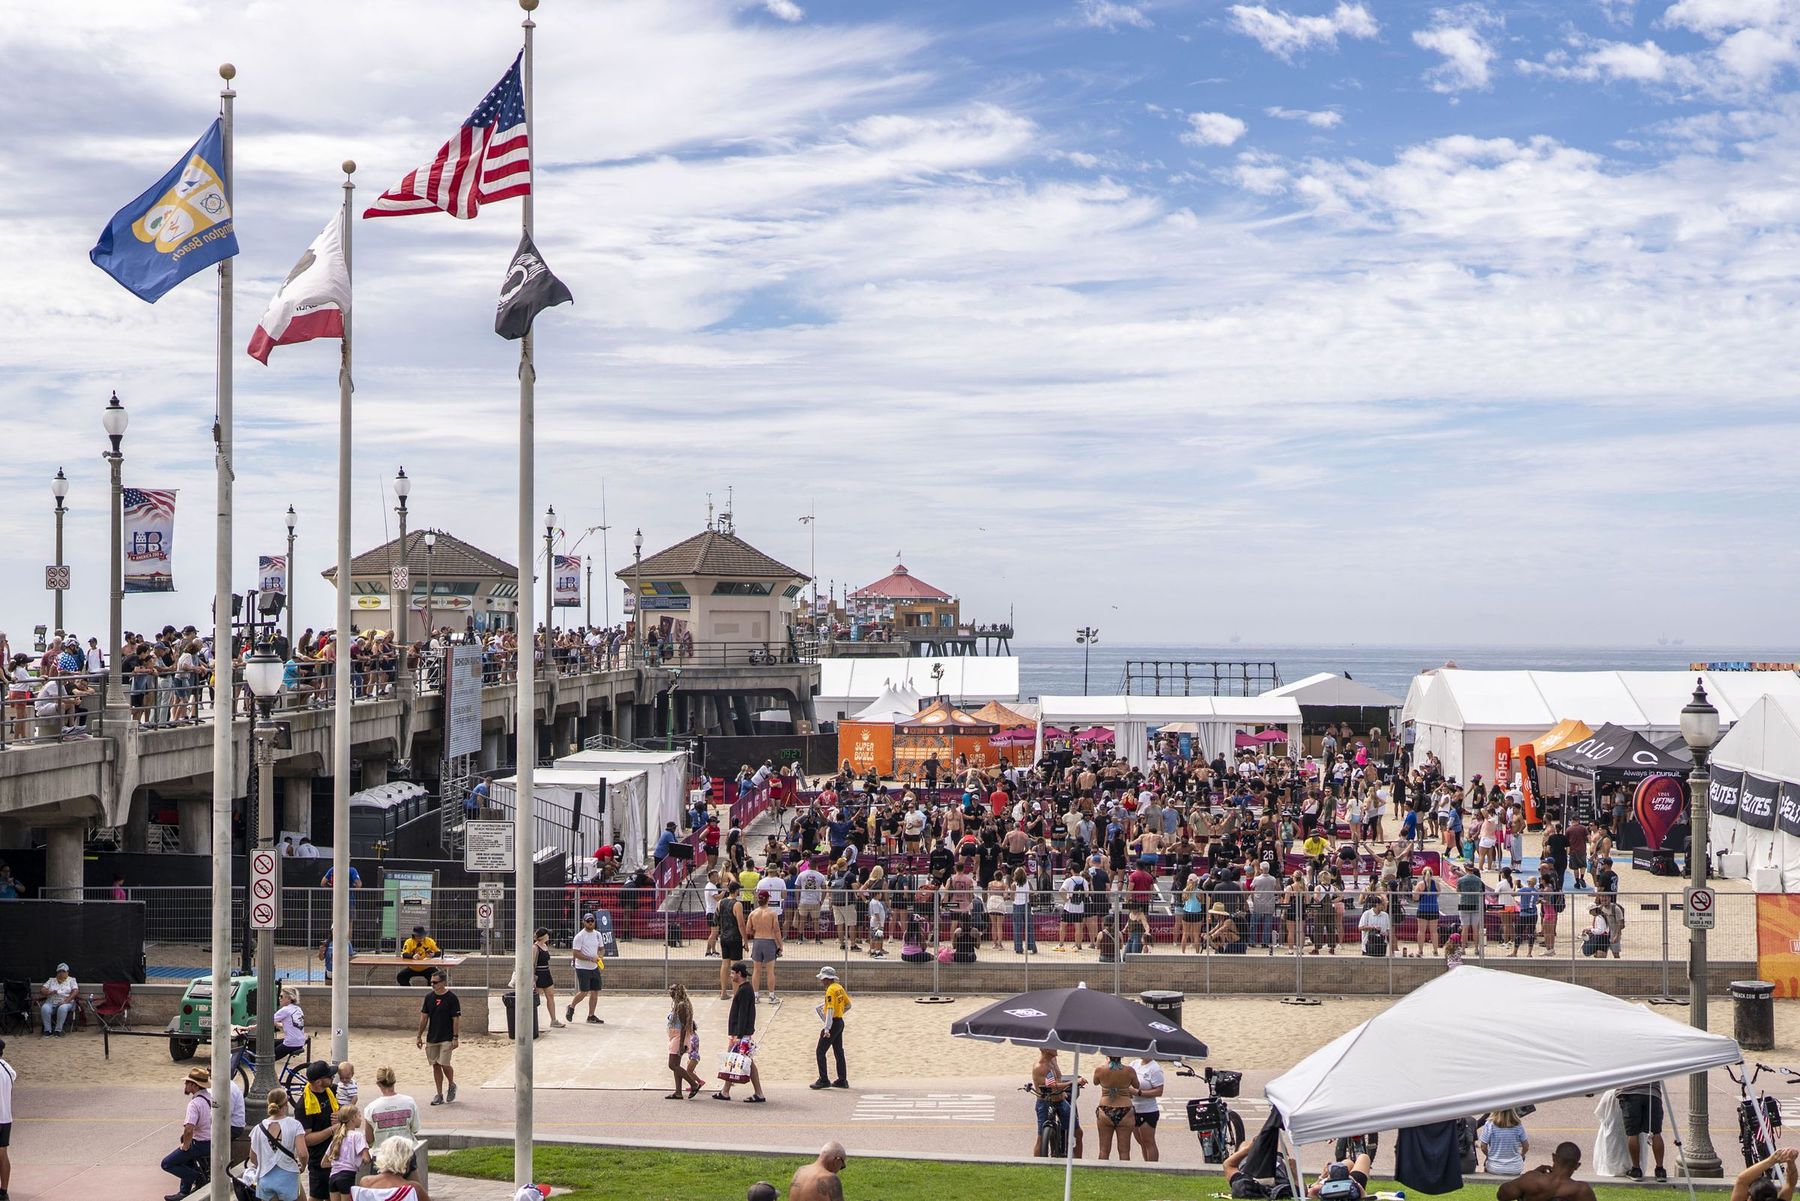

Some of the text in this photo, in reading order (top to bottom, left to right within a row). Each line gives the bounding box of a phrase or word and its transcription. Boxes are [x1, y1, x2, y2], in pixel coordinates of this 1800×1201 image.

[855, 742, 875, 752] SUPER
[854, 752, 875, 761] BOWLS
[1623, 770, 1648, 778] Always
[1263, 850, 1274, 860] 26
